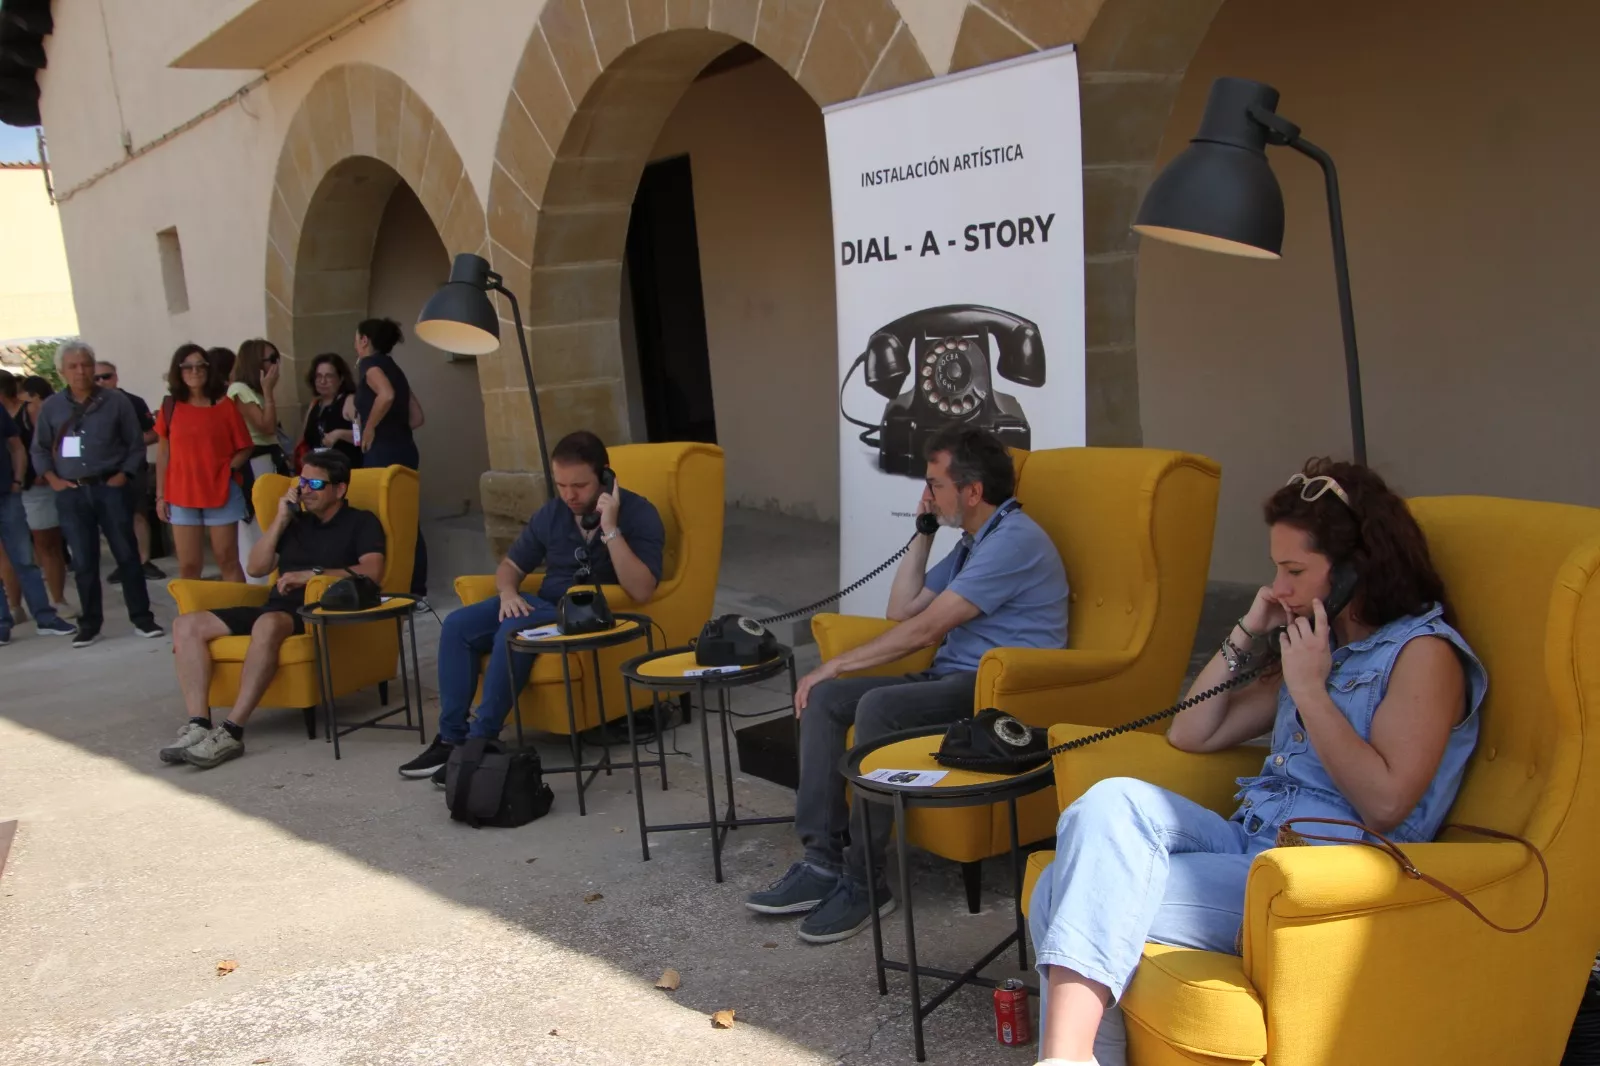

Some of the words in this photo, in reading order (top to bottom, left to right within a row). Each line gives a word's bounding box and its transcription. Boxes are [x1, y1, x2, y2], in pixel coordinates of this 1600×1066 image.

[861, 156, 950, 188] INSTALACIÓN
[953, 143, 1024, 172] ARTÍSTICA
[841, 236, 898, 266] DIAL
[920, 230, 940, 257] A
[964, 213, 1056, 252] STORY
